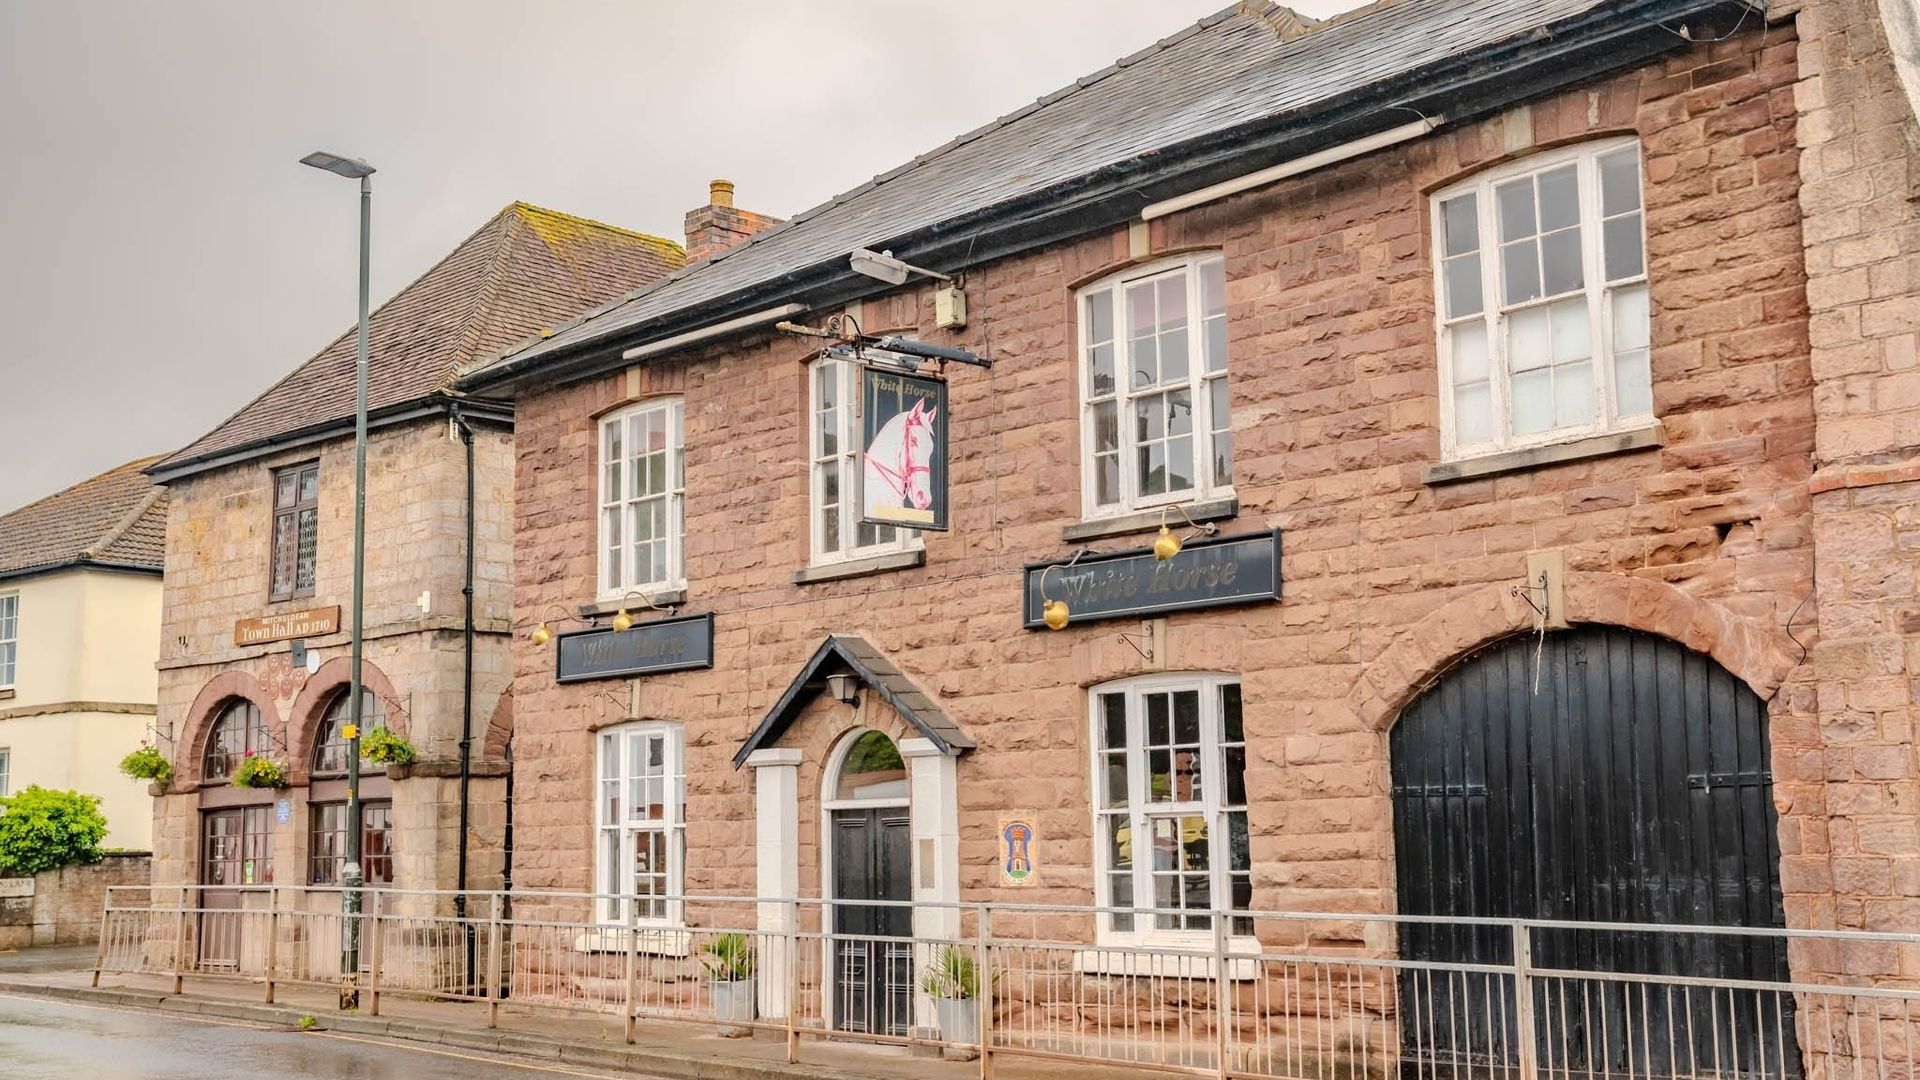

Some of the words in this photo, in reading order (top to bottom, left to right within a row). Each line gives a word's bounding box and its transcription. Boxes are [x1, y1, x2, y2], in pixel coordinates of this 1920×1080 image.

[872, 374, 903, 393] White
[904, 383, 936, 398] Horse
[1060, 567, 1138, 602] White
[1147, 561, 1237, 594] Horse
[242, 626, 270, 641] Town
[272, 621, 293, 637] Hall
[295, 622, 309, 635] AD
